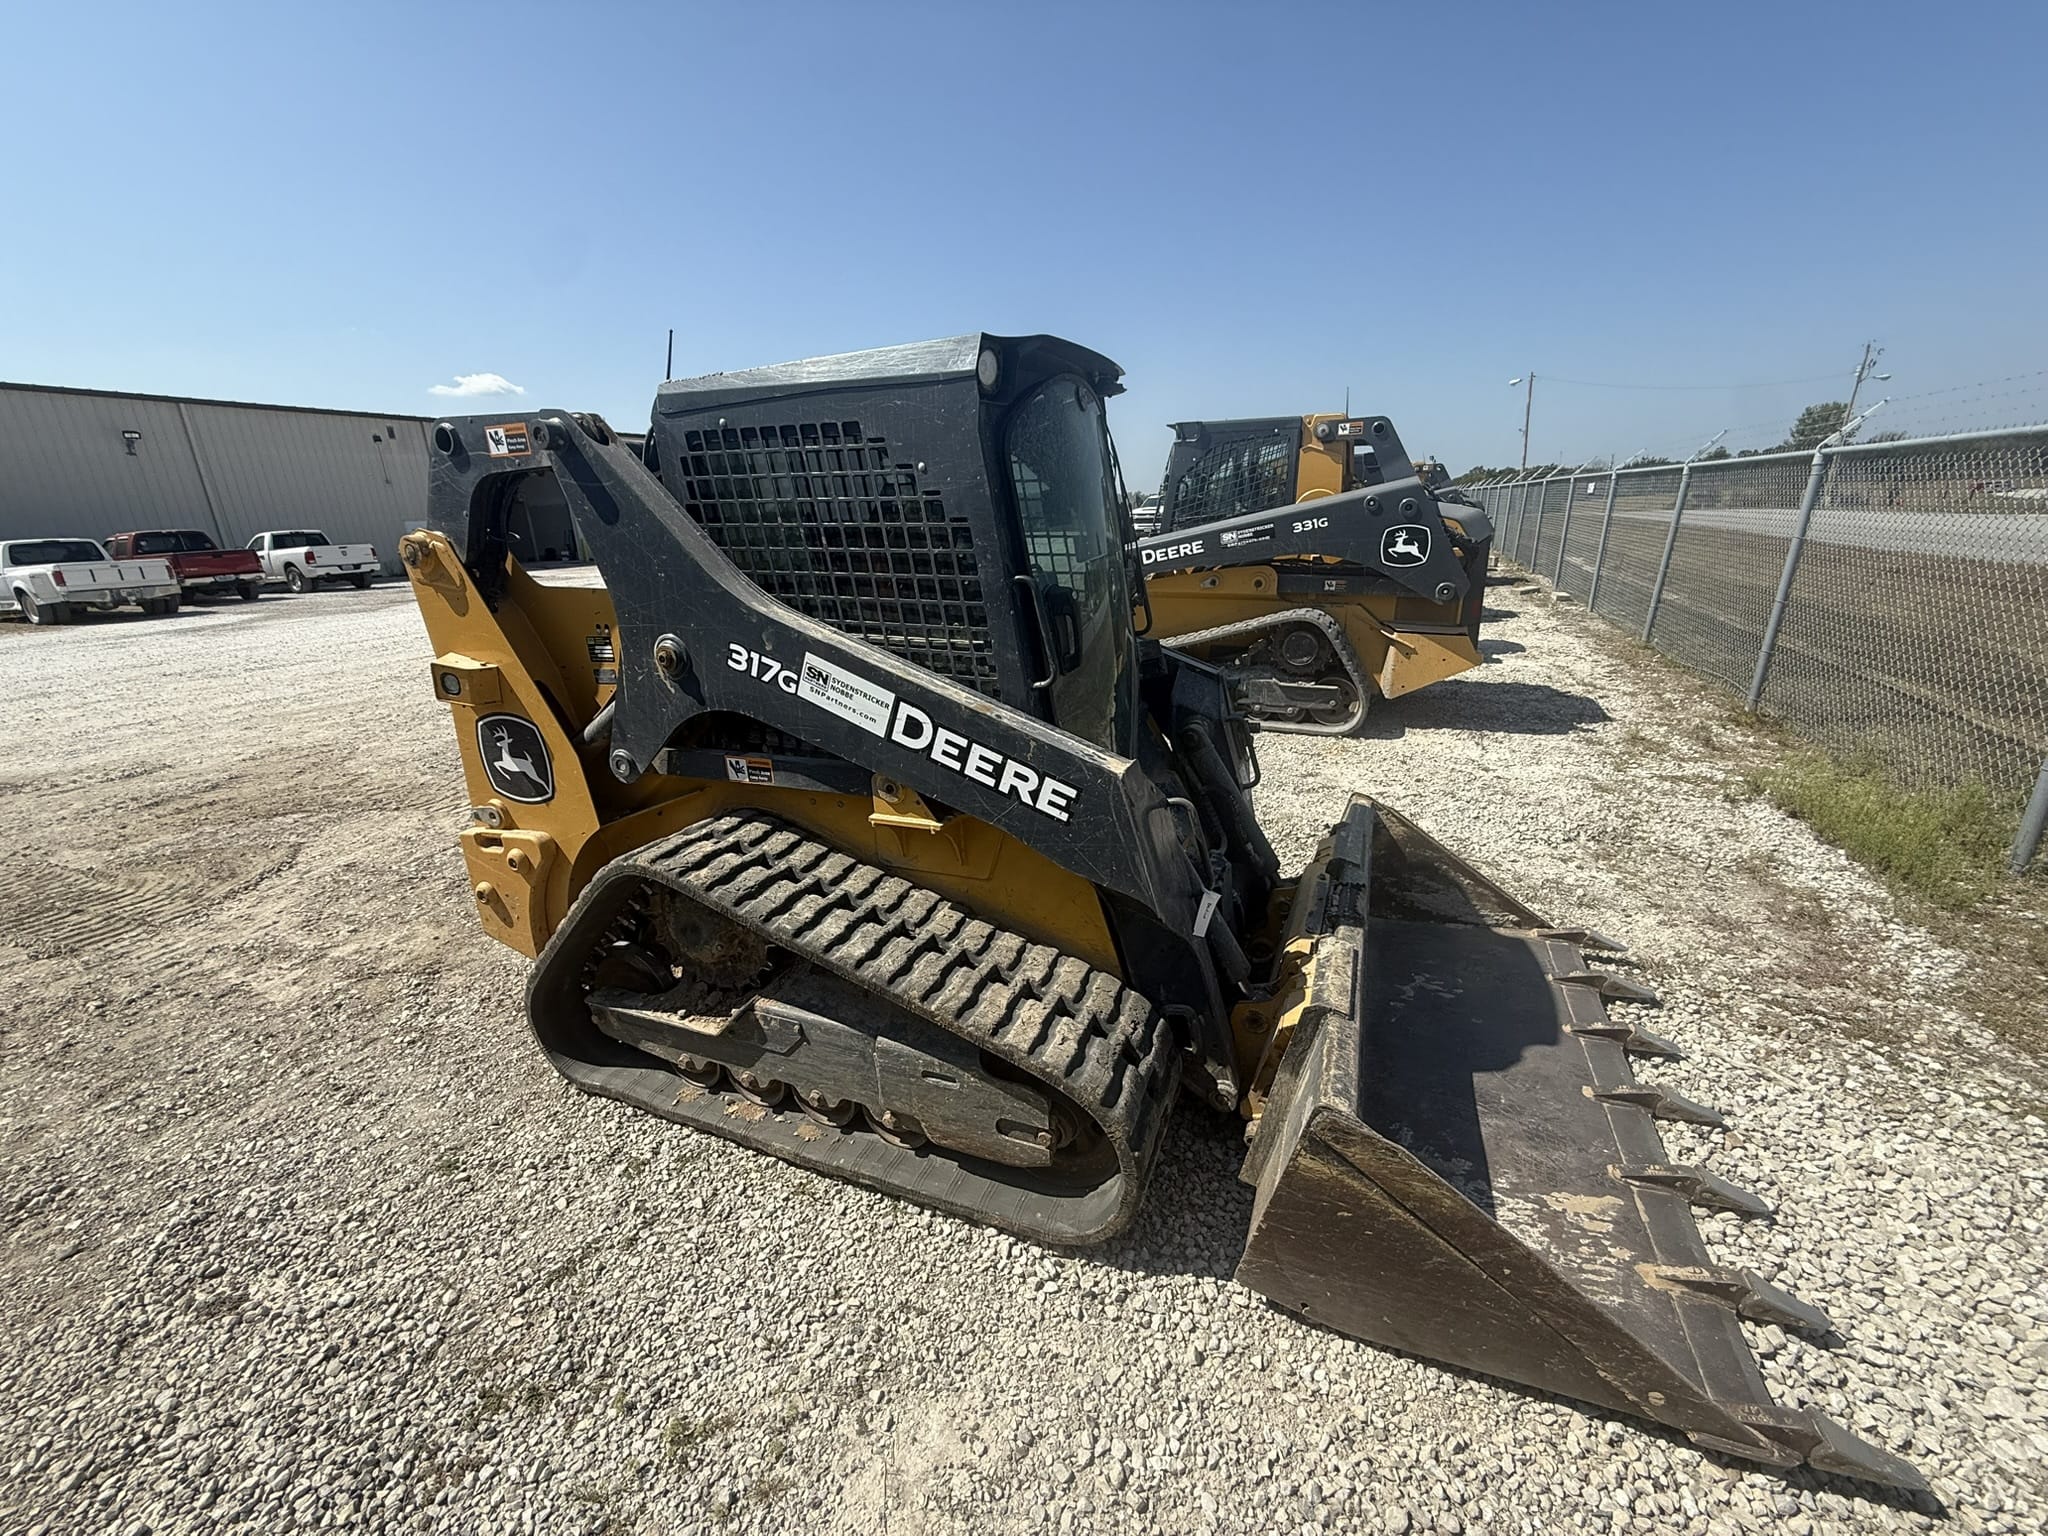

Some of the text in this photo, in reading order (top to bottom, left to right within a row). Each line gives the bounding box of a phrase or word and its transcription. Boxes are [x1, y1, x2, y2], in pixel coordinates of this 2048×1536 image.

[1292, 517, 1329, 533] 331G
[1141, 540, 1205, 565] DEERE
[727, 643, 799, 695] 317G
[809, 686, 877, 724] SNPartners.com
[830, 685, 854, 701] NOBBE
[831, 677, 890, 710] SYDENSTRICKER
[891, 701, 1078, 822] DEERE
